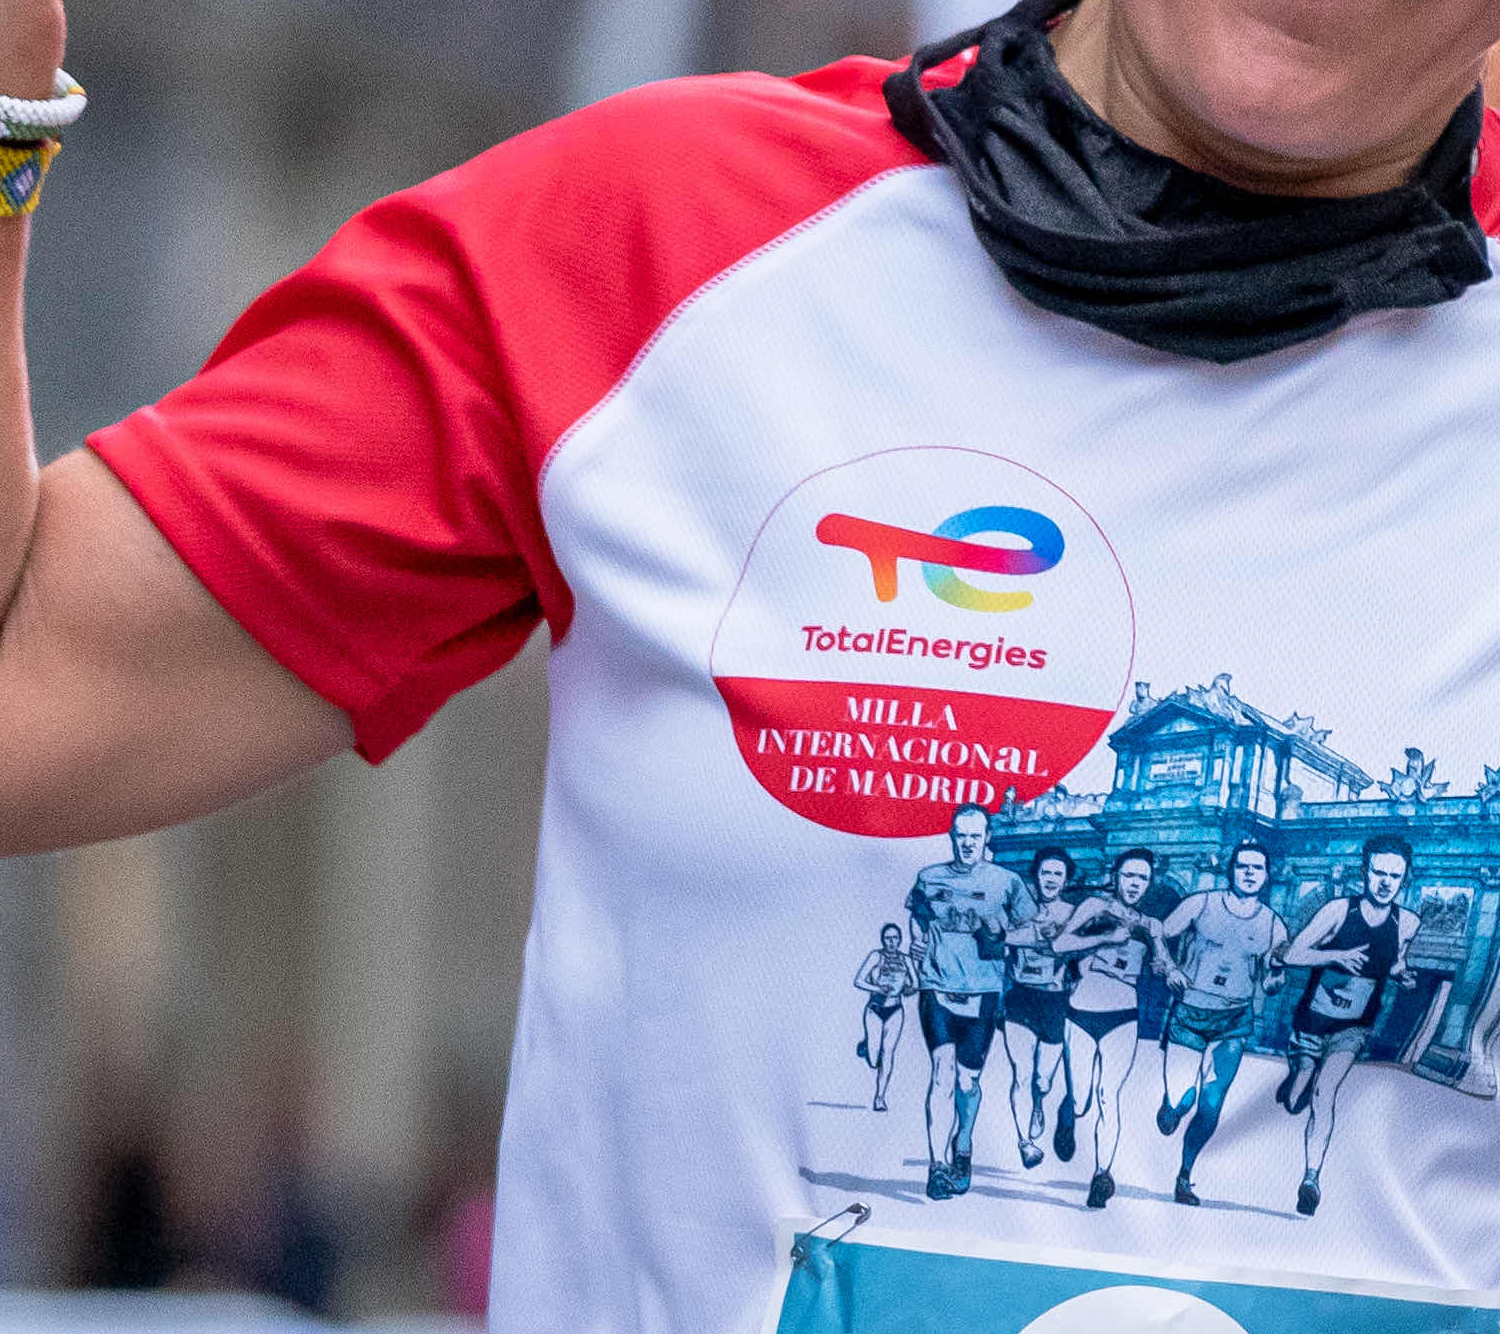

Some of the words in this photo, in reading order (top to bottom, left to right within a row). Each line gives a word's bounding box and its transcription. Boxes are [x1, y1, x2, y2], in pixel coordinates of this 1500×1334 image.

[802, 625, 1047, 669] TotalEnergies
[846, 696, 958, 731] MILLA
[789, 765, 836, 793] DE
[849, 768, 996, 806] MADRID
